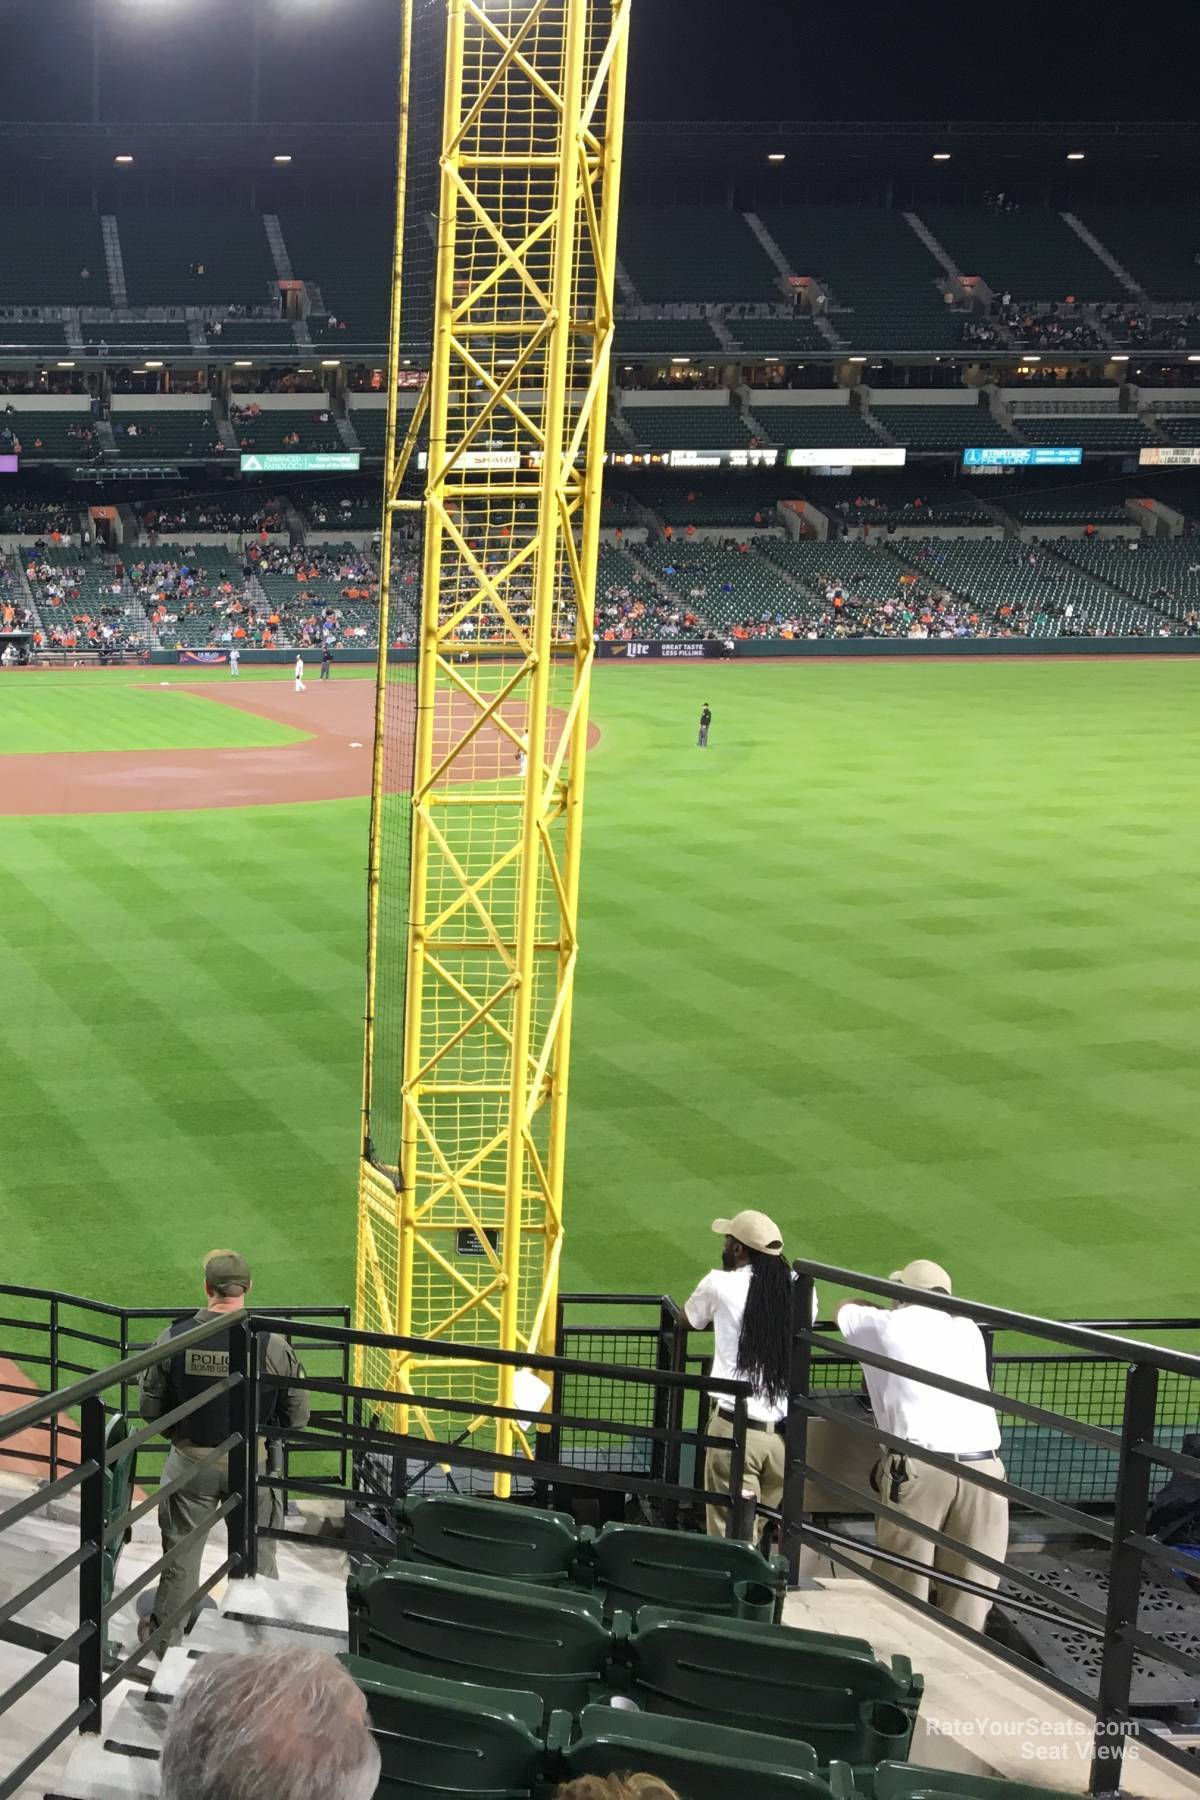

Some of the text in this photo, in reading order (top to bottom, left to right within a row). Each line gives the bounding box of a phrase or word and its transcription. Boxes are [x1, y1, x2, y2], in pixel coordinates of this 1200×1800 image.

[264, 462, 302, 470] RADIOLOGY
[981, 456, 1030, 465] FACTORY
[626, 642, 649, 657] Lite
[191, 1353, 230, 1366] POLIC
